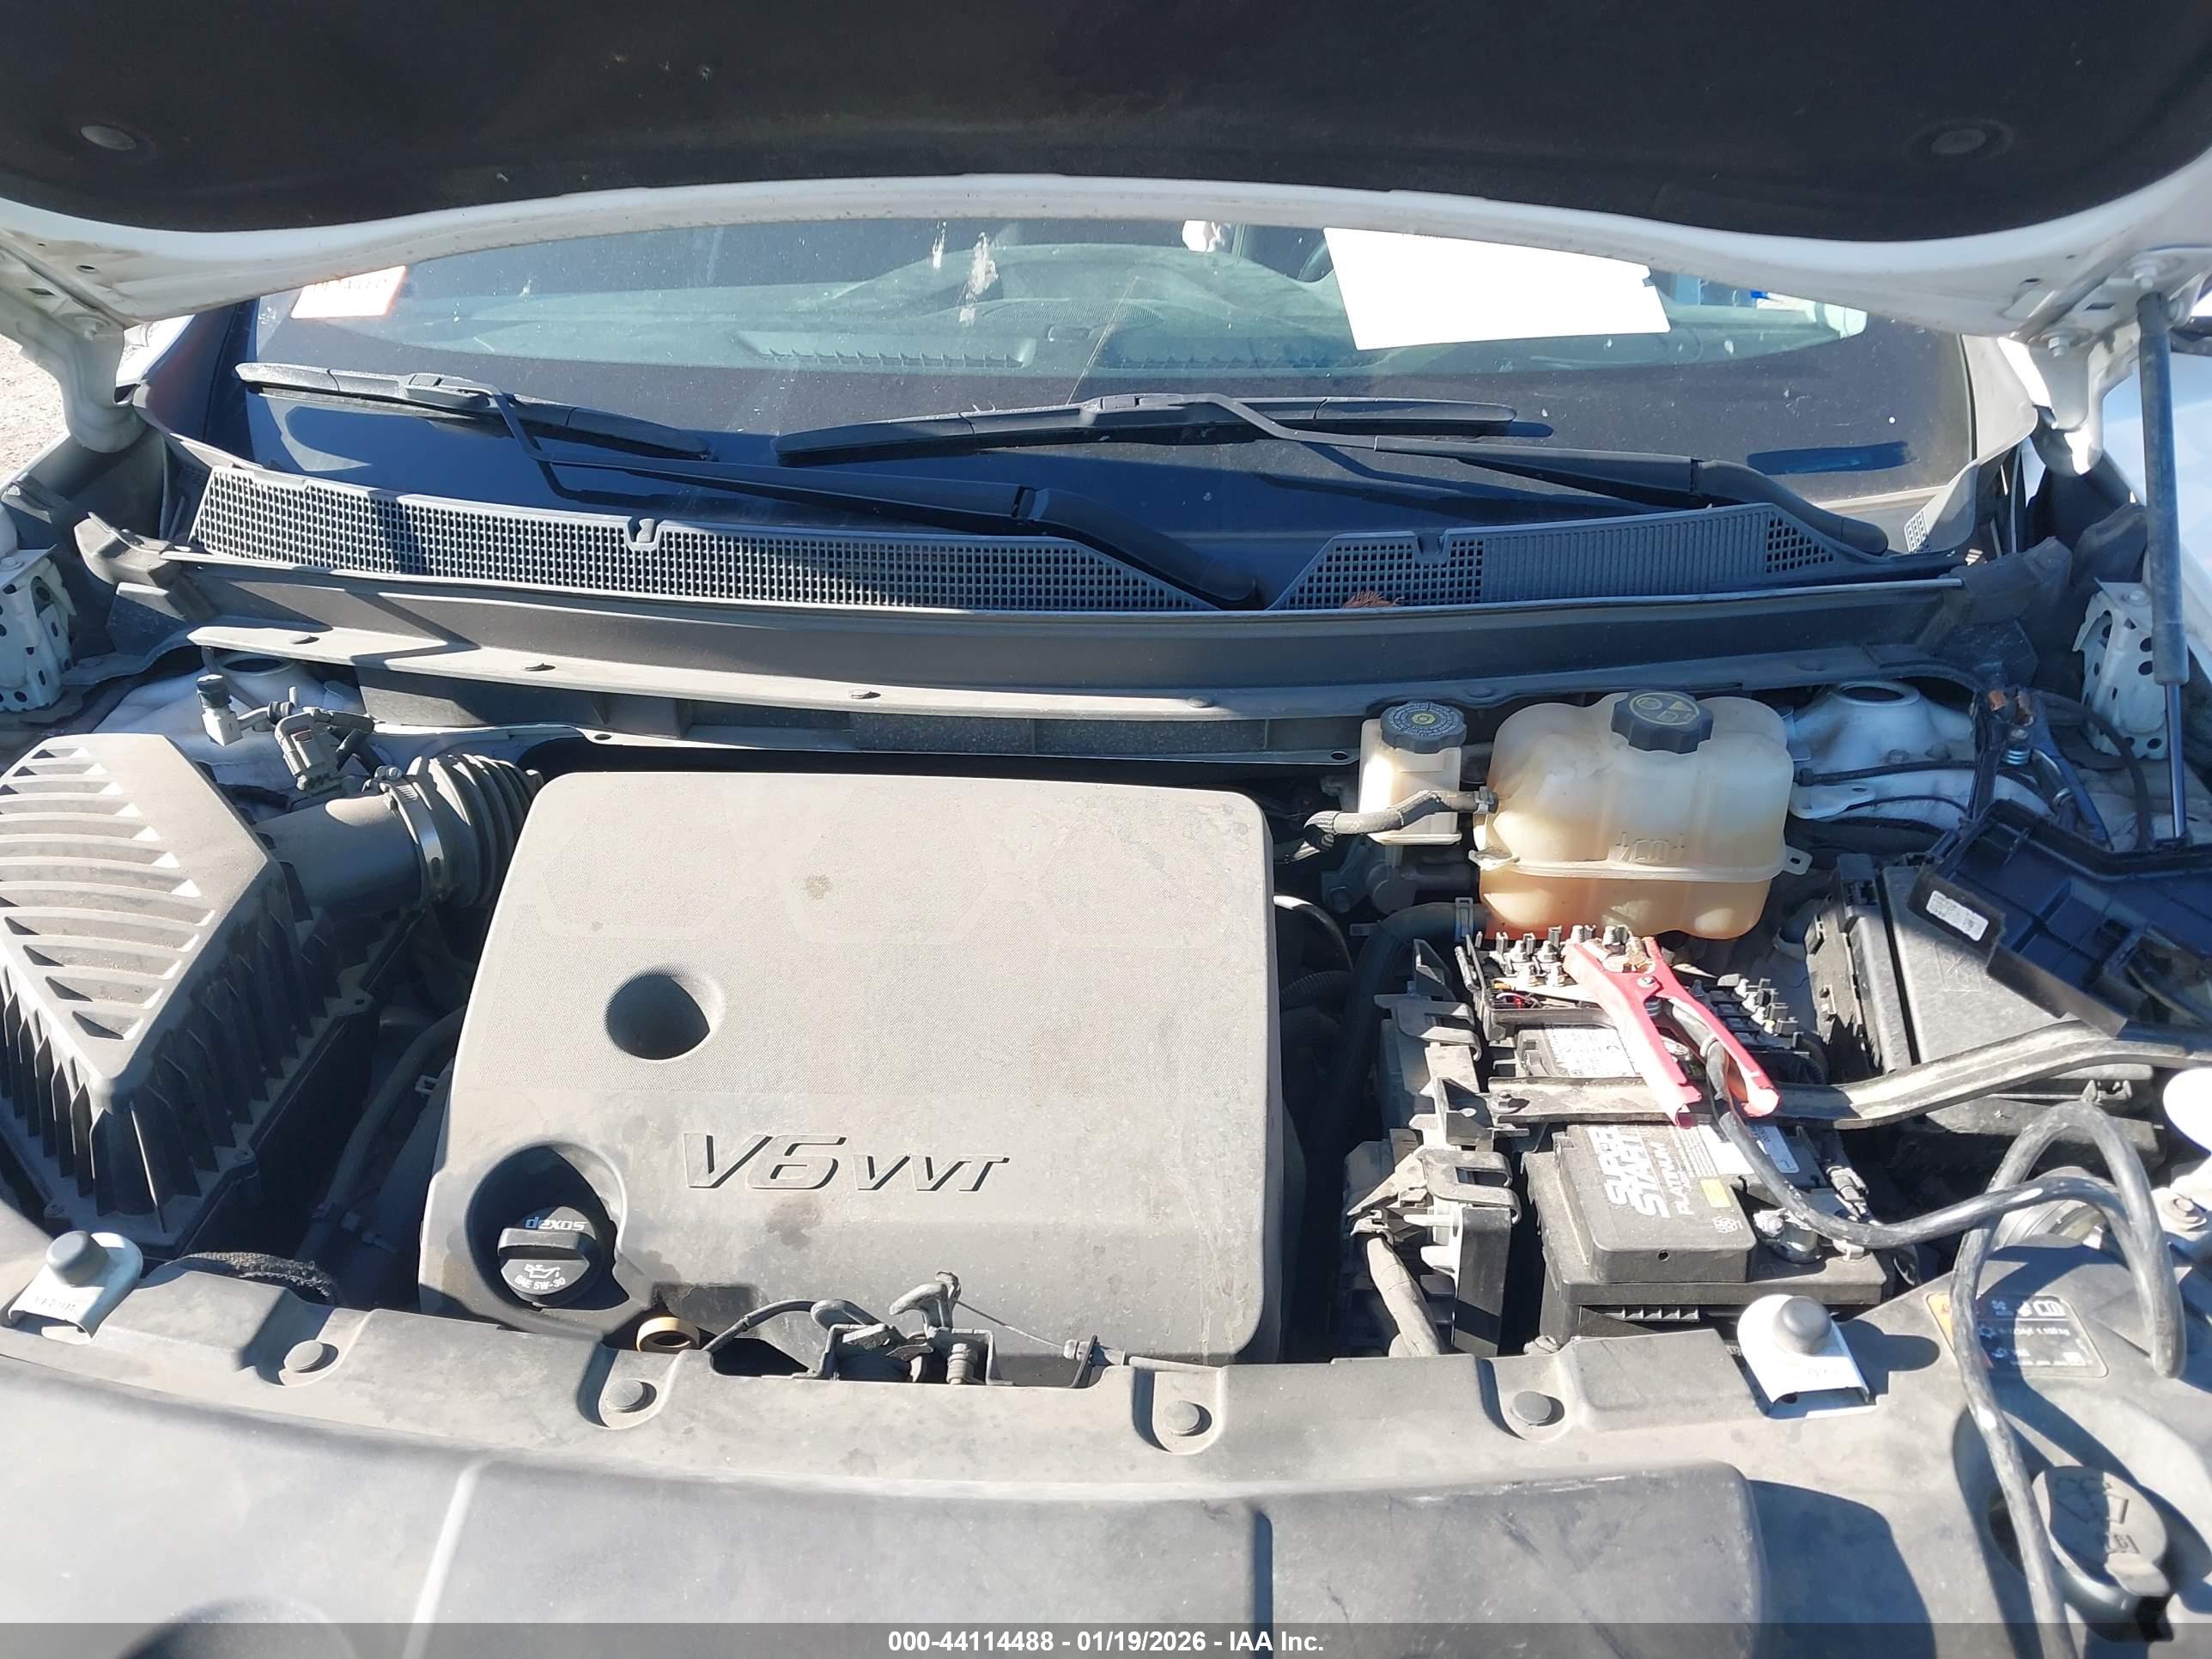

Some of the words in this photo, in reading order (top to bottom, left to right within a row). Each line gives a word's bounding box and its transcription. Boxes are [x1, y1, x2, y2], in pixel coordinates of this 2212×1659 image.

[684, 1133, 848, 1190] V6
[852, 1153, 1011, 1192] VVT
[1586, 1126, 1630, 1206] SUPER
[1610, 1126, 1671, 1218] START
[1648, 1140, 1695, 1216] PLATINUM
[525, 1216, 589, 1231] dexos
[514, 1274, 532, 1289] SAE
[532, 1276, 566, 1291] 5W-30
